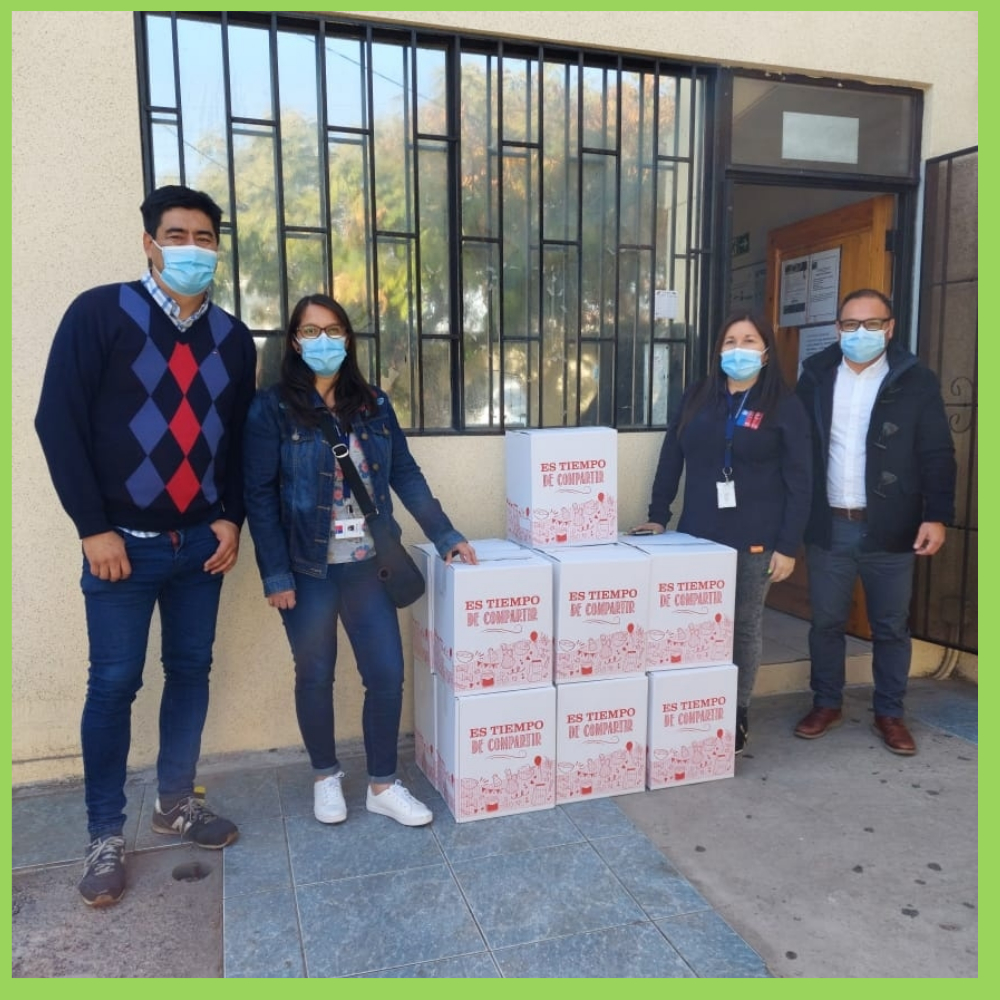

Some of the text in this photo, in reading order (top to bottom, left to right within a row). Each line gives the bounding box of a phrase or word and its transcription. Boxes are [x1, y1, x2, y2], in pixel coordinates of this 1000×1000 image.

[540, 459, 607, 473] ES TIEMPO
[542, 470, 604, 487] DE COMPARTIR
[658, 579, 725, 592] ES TIEMPO
[465, 595, 541, 611] ES TIEMPO
[568, 588, 638, 602] ES TIEMPO
[659, 591, 723, 608] DE COMPARTIR
[467, 607, 539, 627] DE COMPARTIR
[570, 600, 635, 617] DE COMPARTIR
[662, 696, 726, 713] ES TIEMPO
[567, 707, 636, 724] ES TIEMPO
[663, 707, 724, 728] DE COMPARTIR
[469, 719, 544, 738] ES TIEMPO
[568, 718, 633, 739] DE COMPARTIR
[471, 732, 542, 755] DE COMPARTIR
